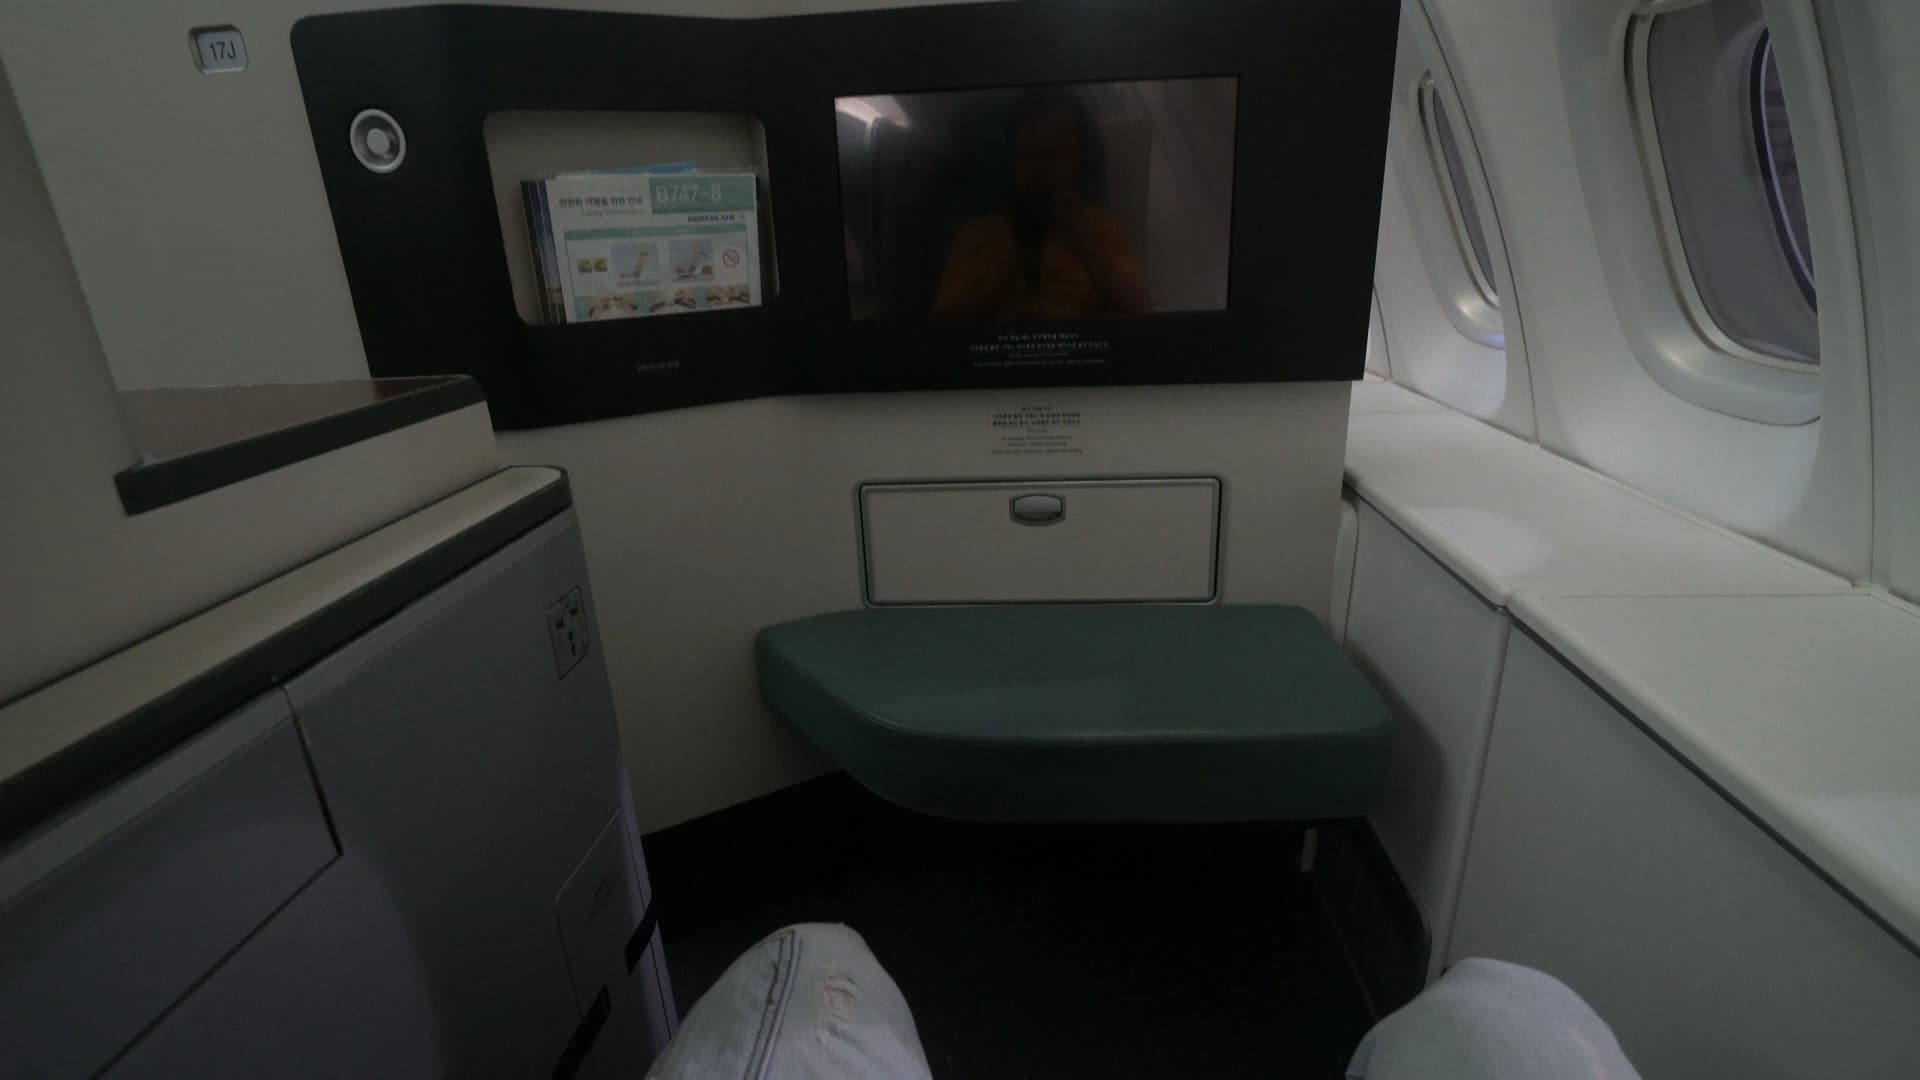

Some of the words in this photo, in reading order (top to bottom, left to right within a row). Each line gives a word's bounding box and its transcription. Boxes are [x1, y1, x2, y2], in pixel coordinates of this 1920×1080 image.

[208, 41, 236, 60] 17J
[655, 183, 722, 203] B747-8
[688, 215, 719, 223] EAN
